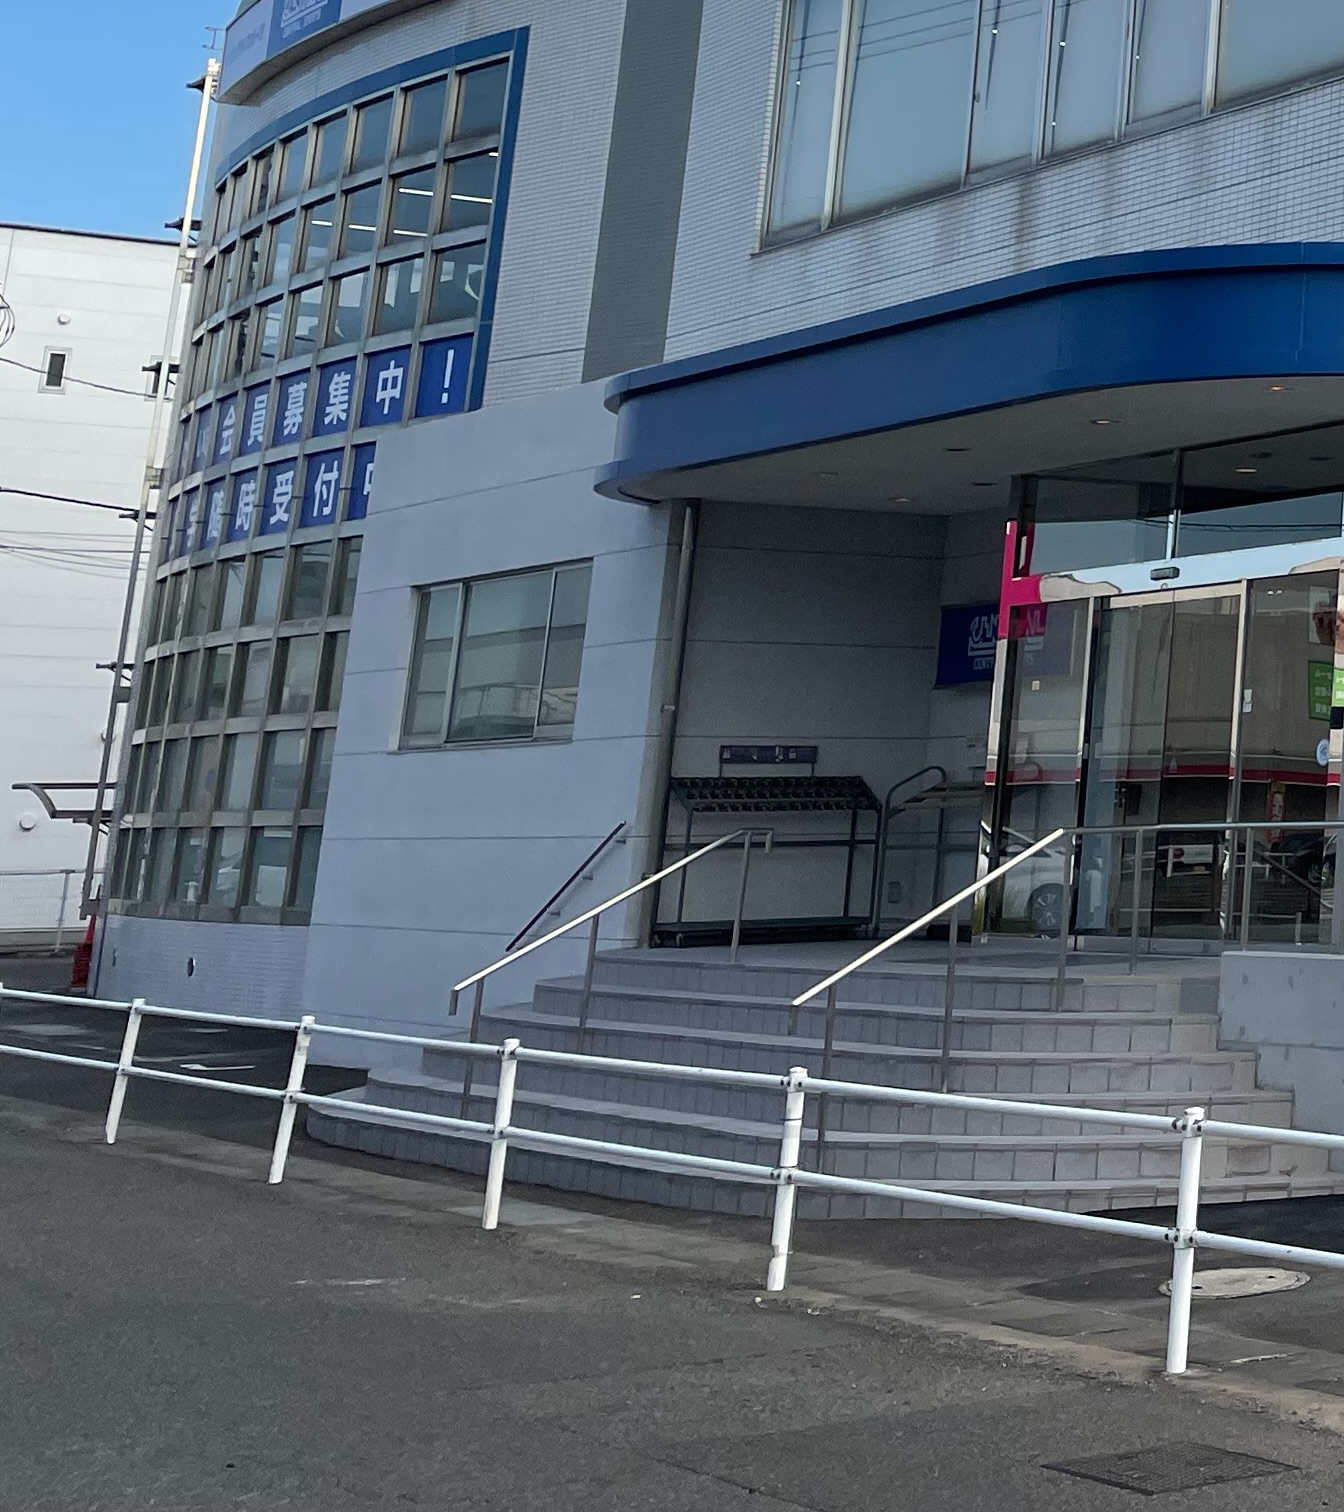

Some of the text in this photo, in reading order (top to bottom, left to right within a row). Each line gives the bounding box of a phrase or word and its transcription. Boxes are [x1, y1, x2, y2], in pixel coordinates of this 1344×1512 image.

[181, 348, 455, 473] 会員募集中！
